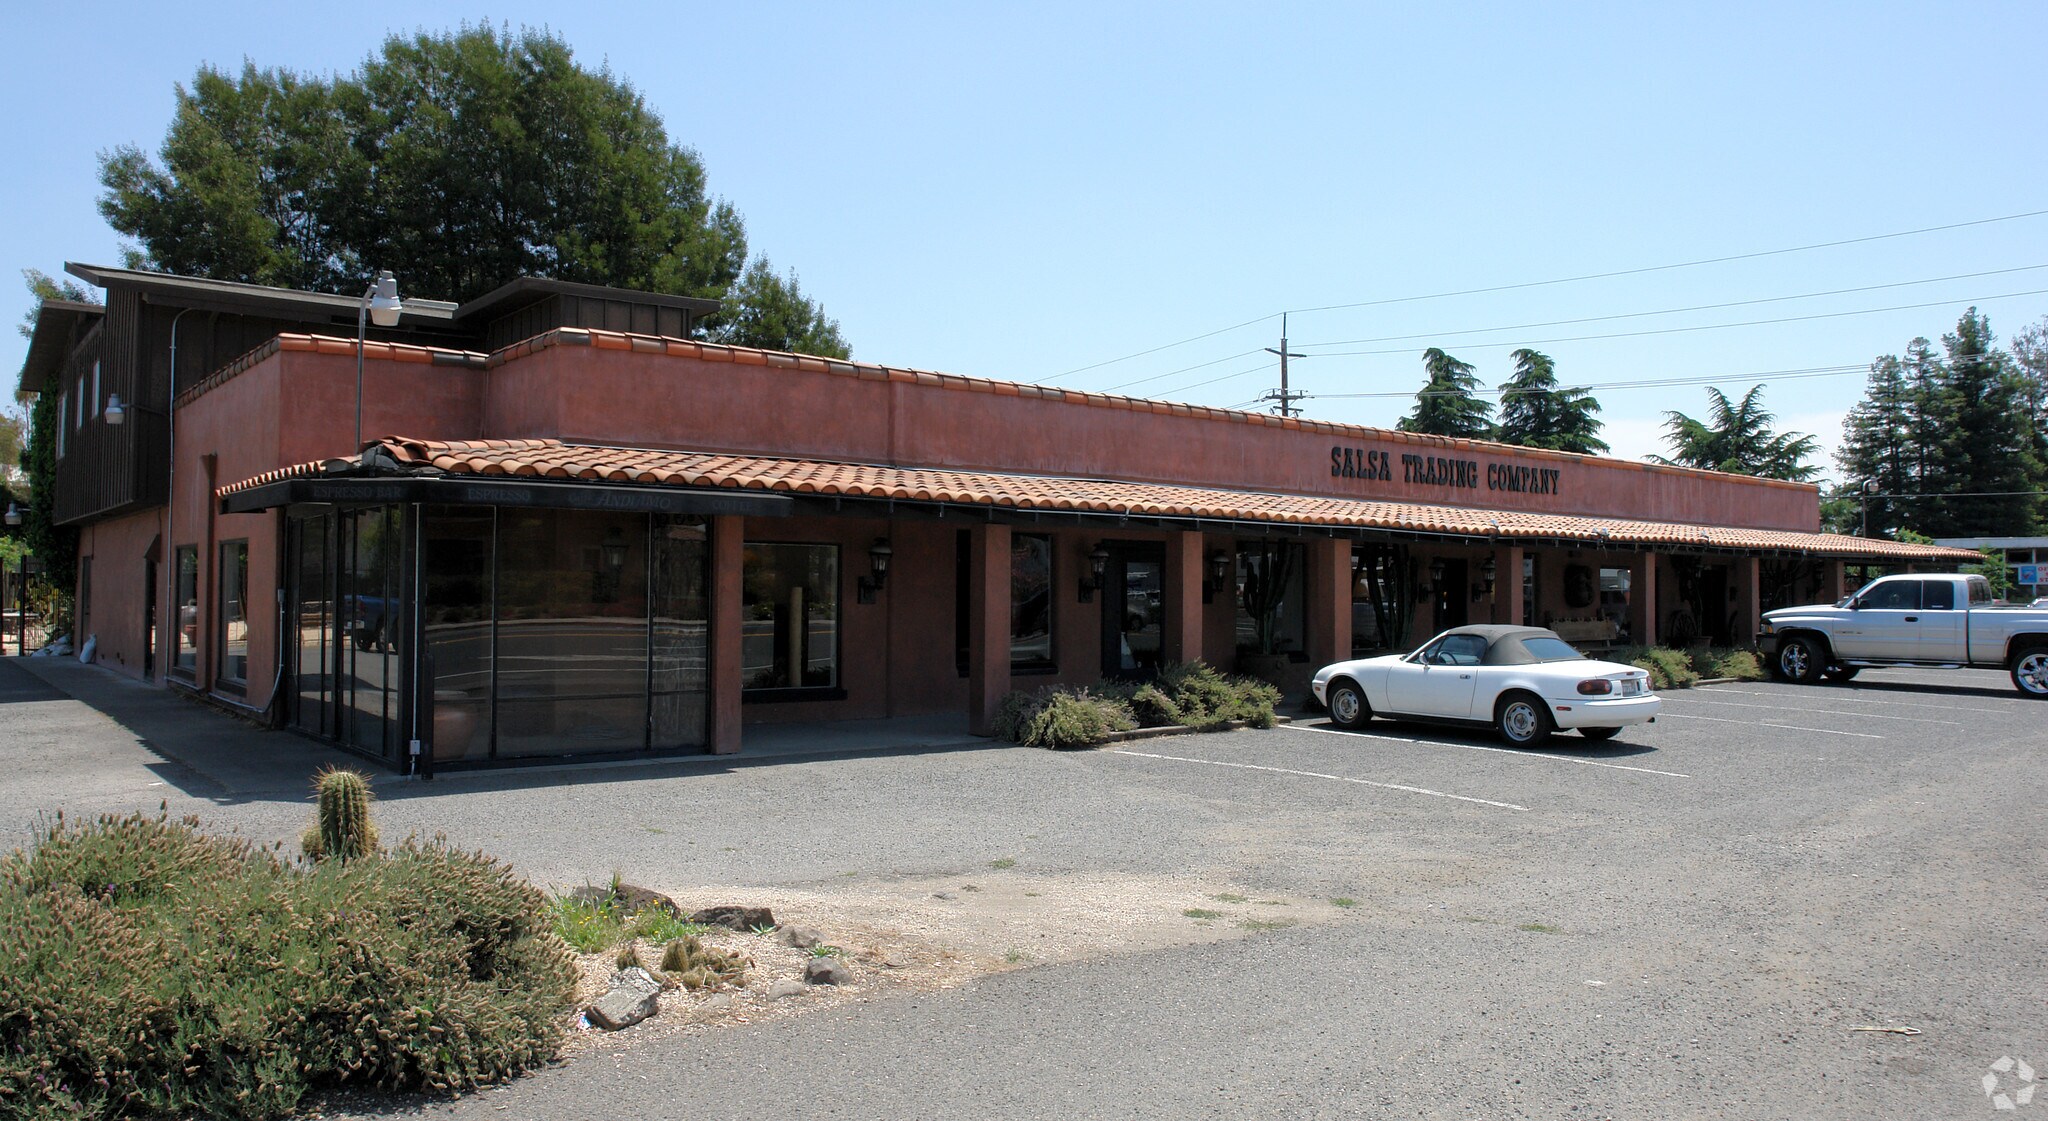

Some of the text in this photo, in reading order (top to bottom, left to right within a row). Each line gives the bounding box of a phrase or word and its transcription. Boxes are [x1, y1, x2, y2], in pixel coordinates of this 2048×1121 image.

[1331, 446, 1560, 494] SALSA TRADING COMPANY
[313, 486, 401, 498] ESPRESSO BAR
[467, 487, 530, 503] ESPRESSO
